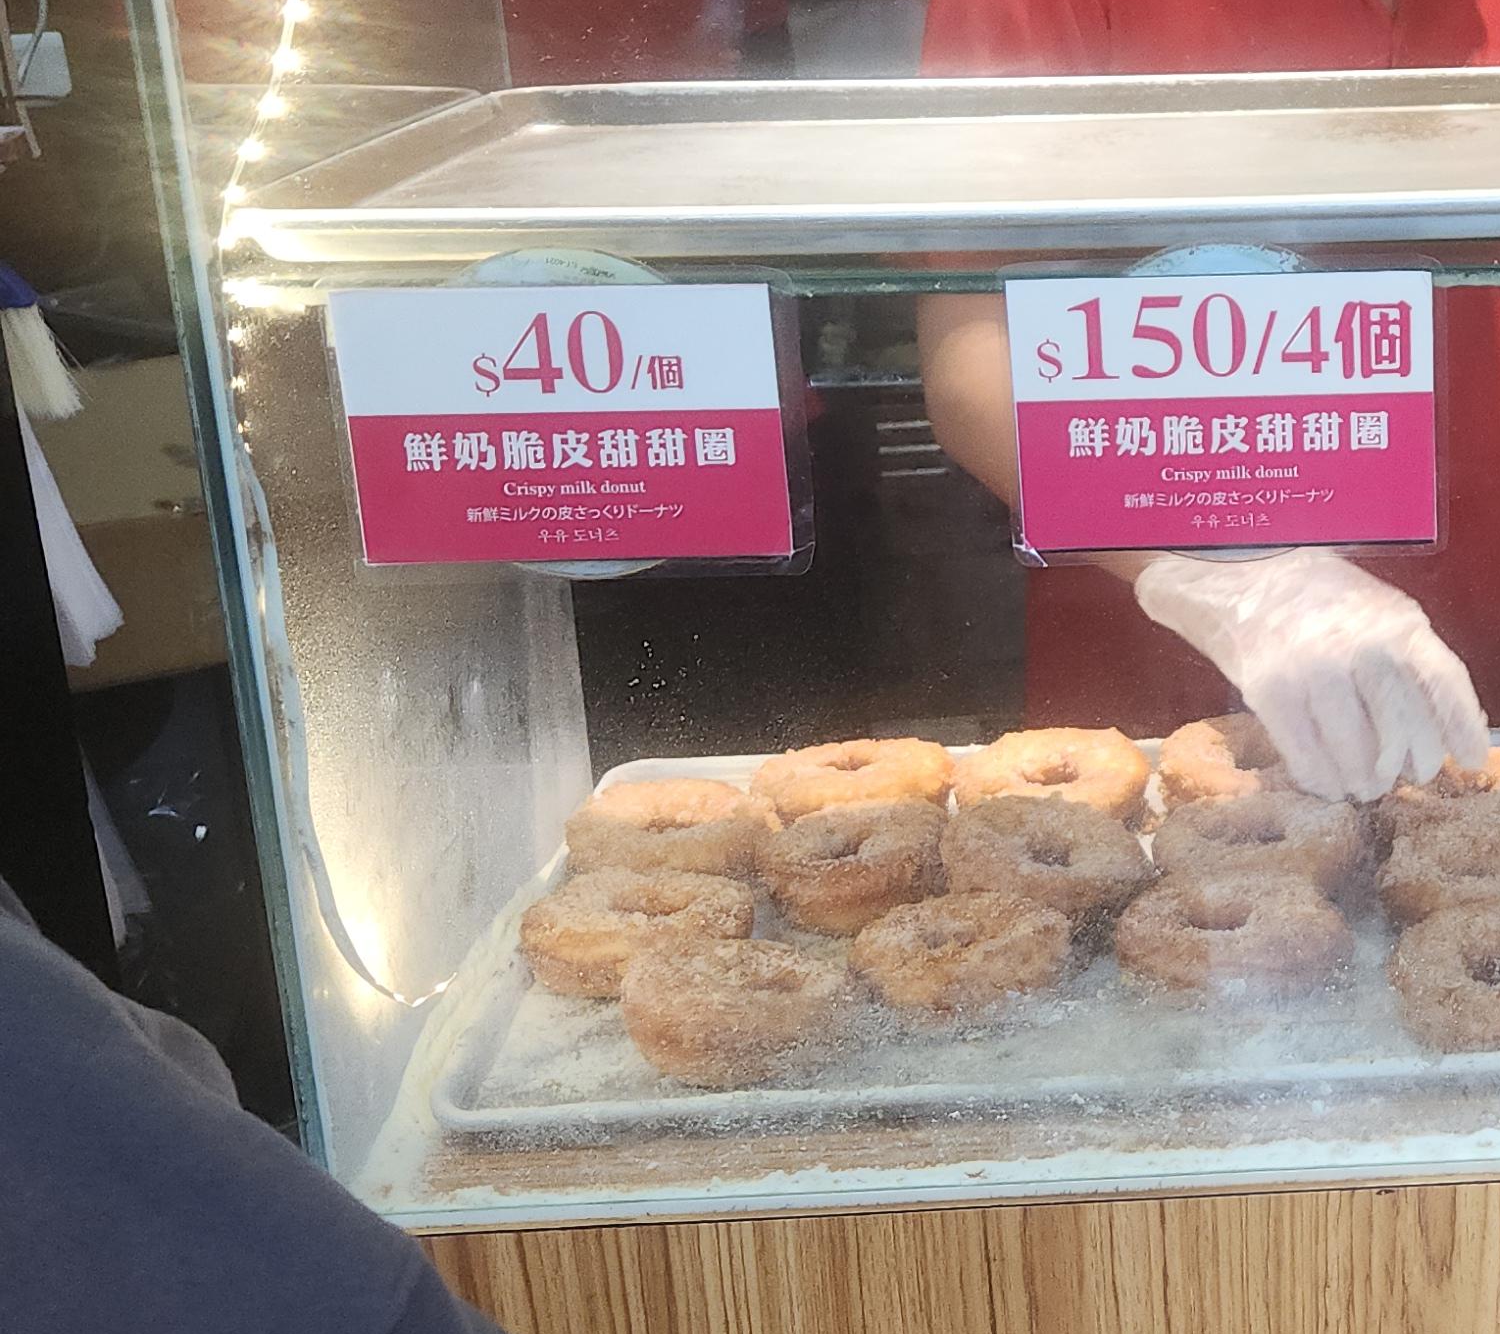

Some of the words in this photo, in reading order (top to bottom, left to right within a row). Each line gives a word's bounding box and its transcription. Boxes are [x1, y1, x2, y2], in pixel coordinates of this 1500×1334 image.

[1036, 291, 1412, 384] $150/4個
[472, 310, 684, 397] $40/個
[1066, 410, 1390, 458] 鮮奶脆皮甜甜圈
[403, 426, 737, 472] 鮮奶脆皮甜甜圈
[1161, 466, 1211, 483] Crispy
[1215, 464, 1251, 481] milk
[1255, 464, 1299, 479] donut
[503, 479, 556, 497] Crispy
[560, 479, 597, 496] milk
[601, 479, 647, 495] donut
[1124, 488, 1334, 509] 新鮮ミルクの皮さっくりドーナツ
[466, 503, 684, 523] 新鮮ミルクの皮さっくりドーナツ
[1190, 513, 1220, 529] 우유
[1225, 511, 1271, 528] 도너츠
[537, 526, 569, 544] 우유
[573, 526, 620, 543] 도너츠
